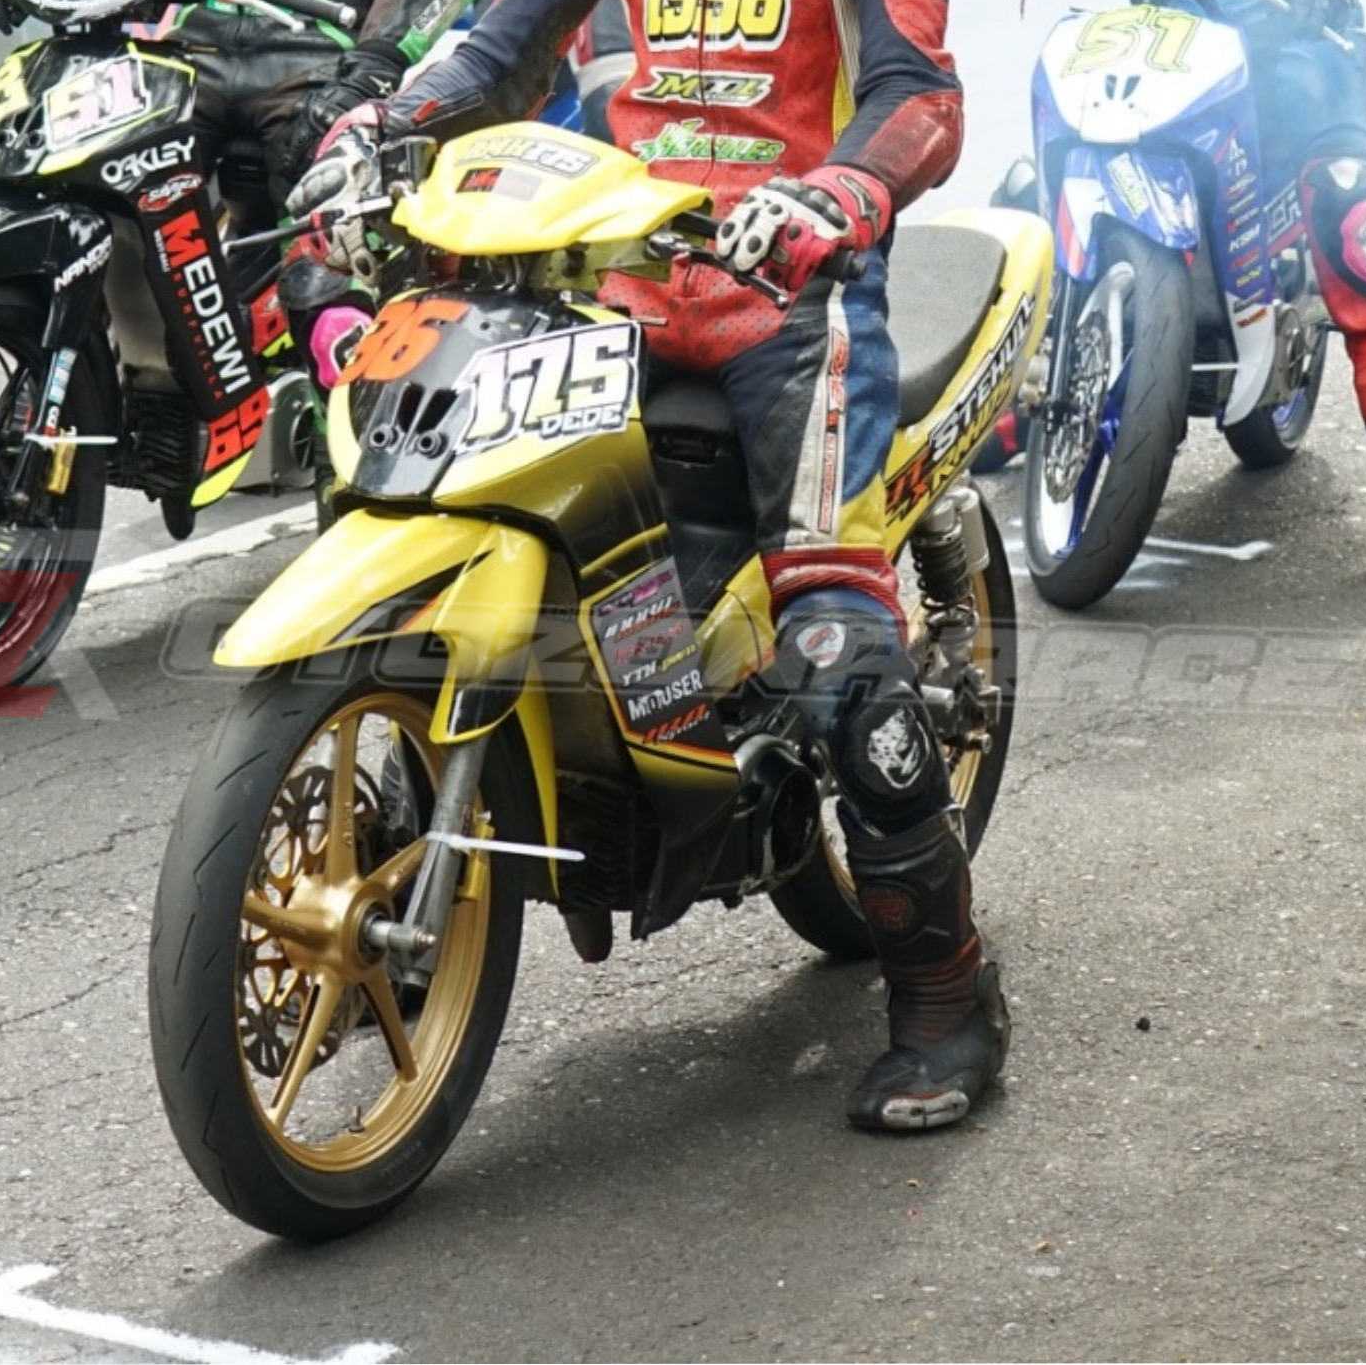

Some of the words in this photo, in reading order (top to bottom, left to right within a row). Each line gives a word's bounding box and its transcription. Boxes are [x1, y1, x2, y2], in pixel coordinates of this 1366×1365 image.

[1062, 3, 1202, 77] 51
[46, 59, 143, 146] 51
[101, 135, 196, 184] OAKLEY
[159, 209, 252, 395] MEDEWI
[463, 324, 633, 443] 175
[541, 403, 624, 436] DEDE
